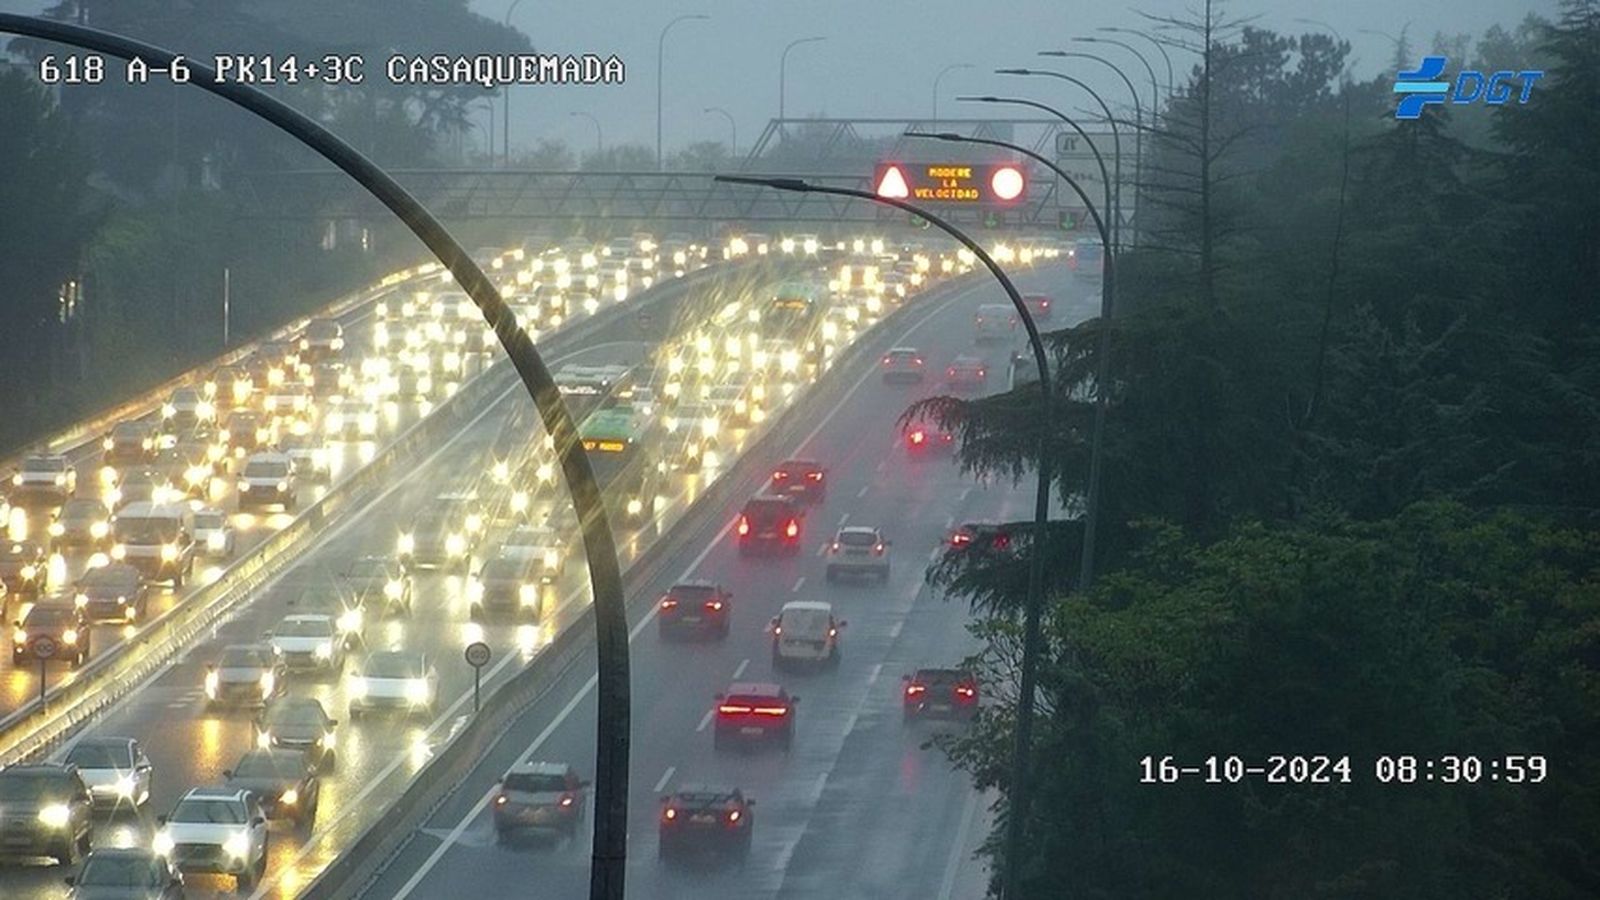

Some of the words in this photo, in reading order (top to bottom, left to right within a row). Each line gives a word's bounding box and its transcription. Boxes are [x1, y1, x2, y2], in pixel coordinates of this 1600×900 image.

[928, 167, 972, 178] MODERE
[943, 179, 958, 188] LA
[914, 188, 980, 199] VELOCIDAD
